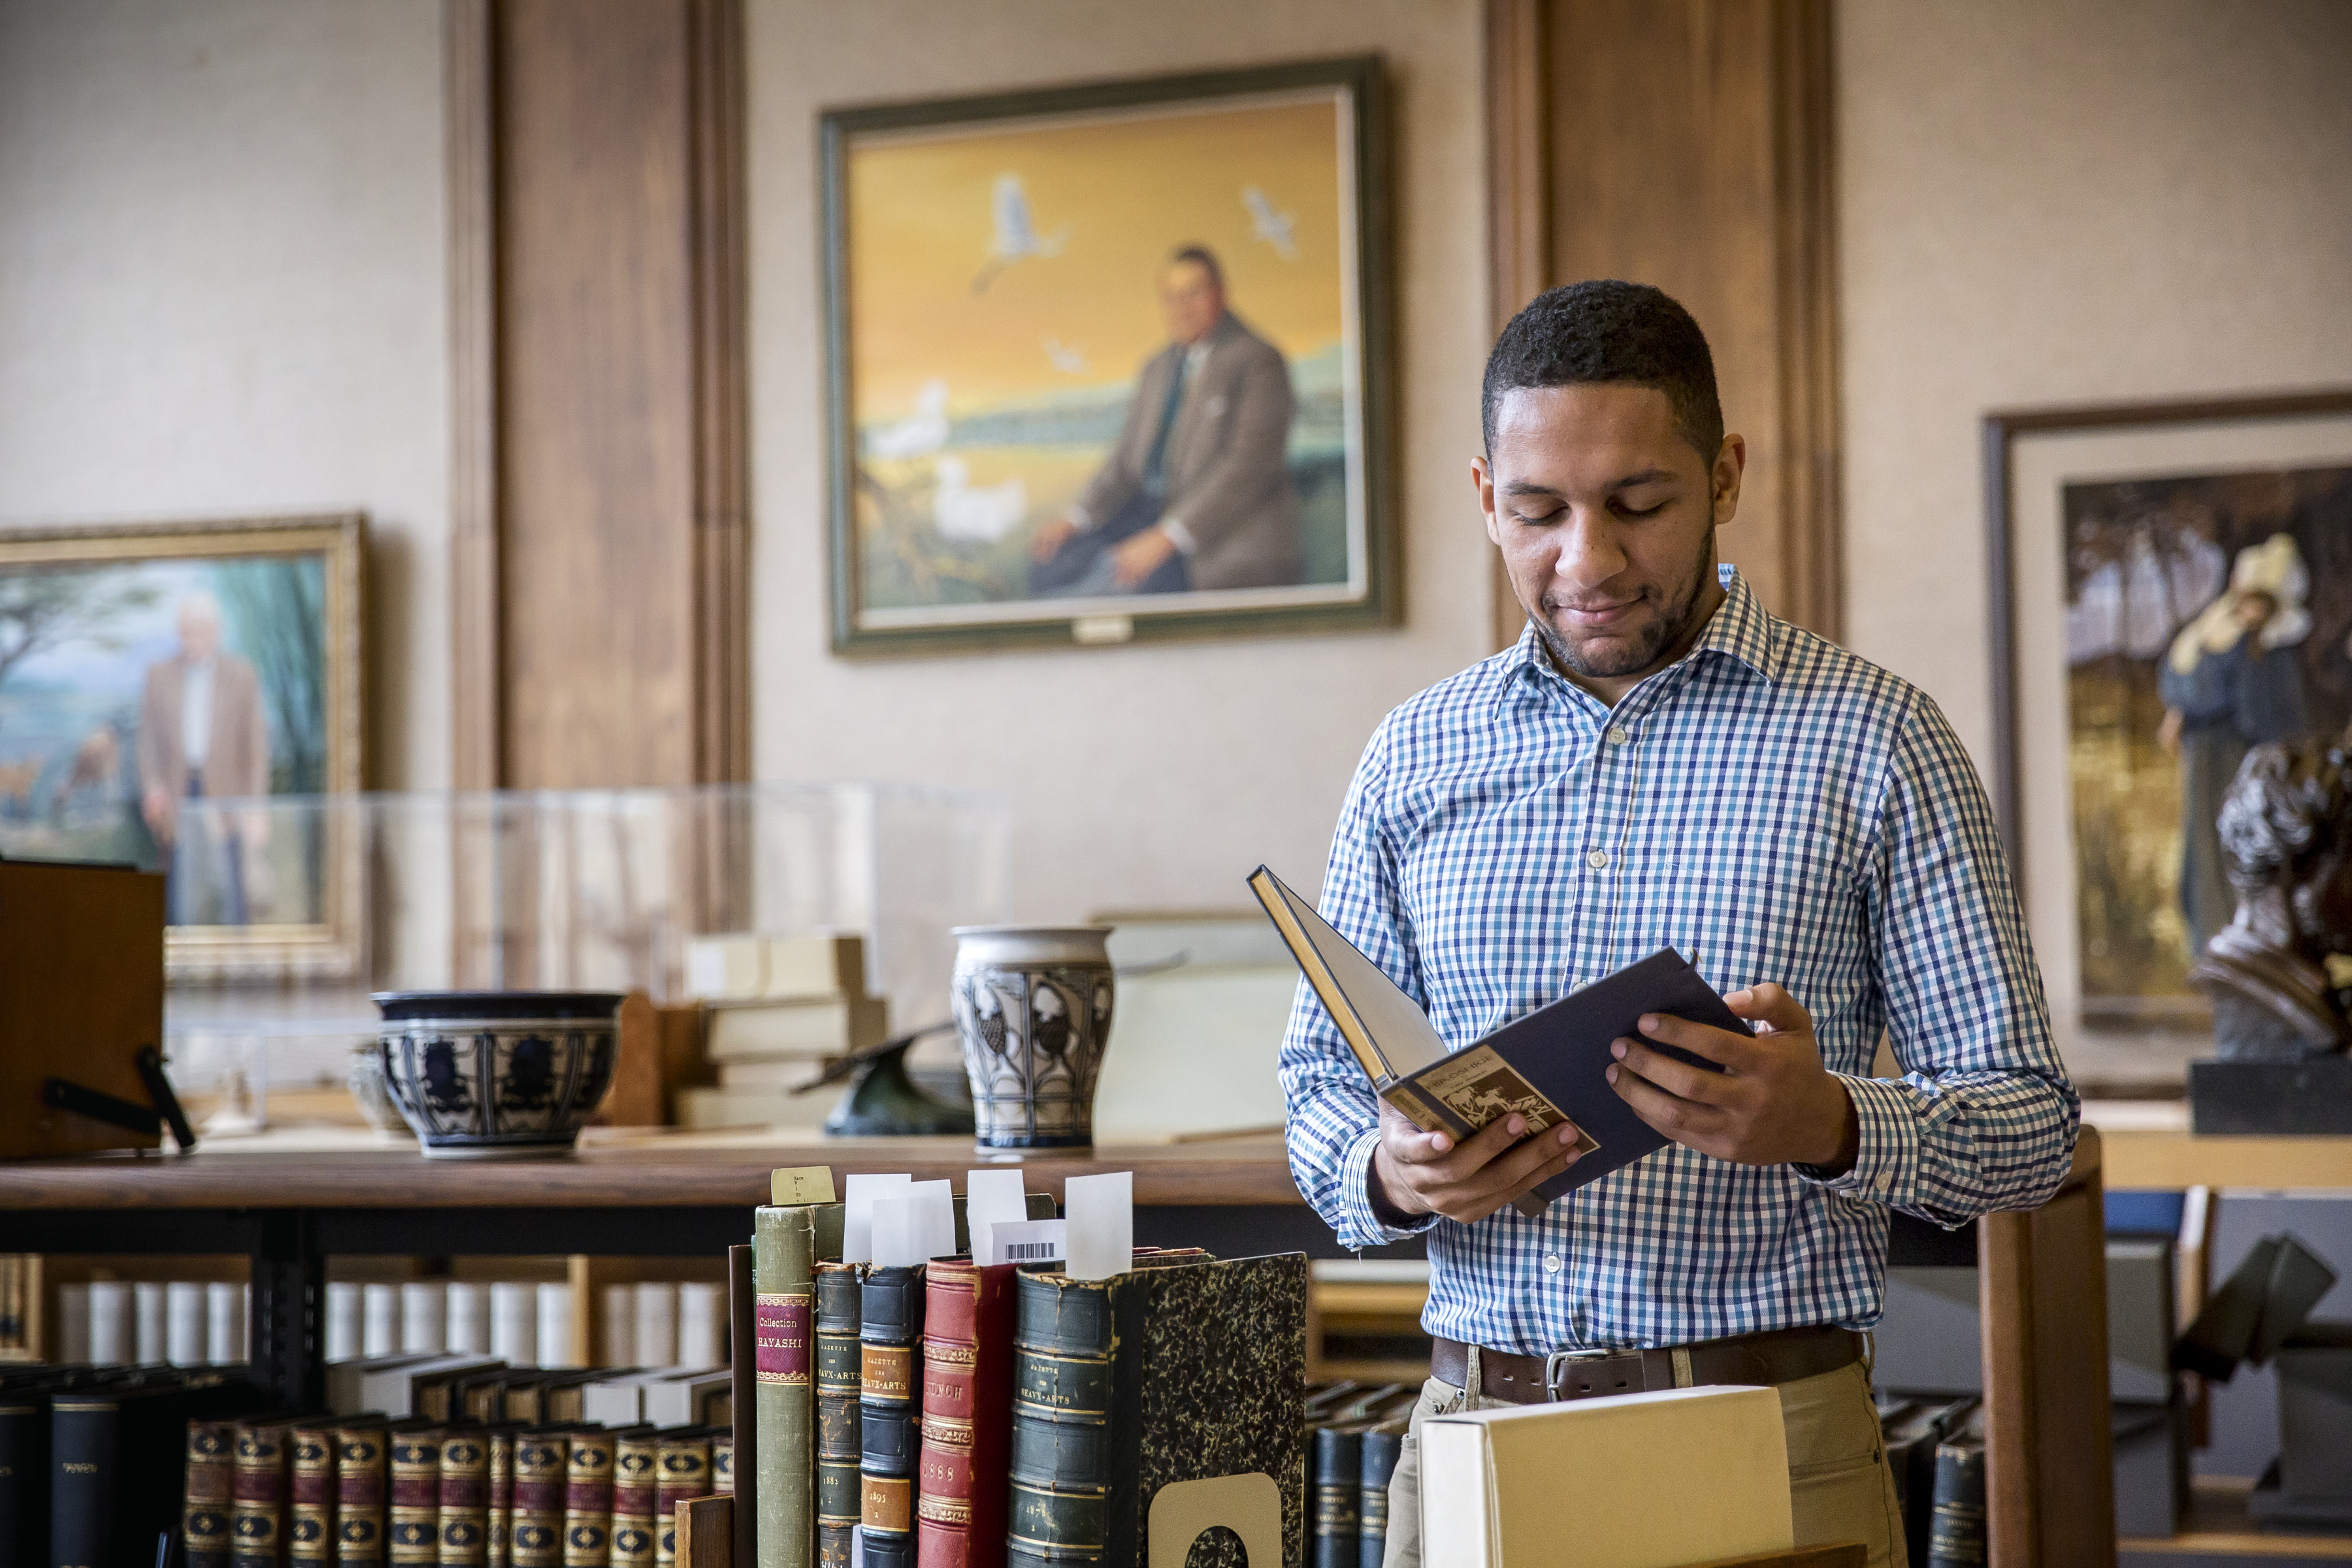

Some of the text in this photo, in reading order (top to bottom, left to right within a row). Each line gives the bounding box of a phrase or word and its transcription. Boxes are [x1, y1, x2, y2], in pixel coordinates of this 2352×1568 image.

[1426, 1054, 1494, 1090] HIROSHIGE
[759, 1317, 797, 1328] Collection
[758, 1337, 802, 1348] HAYASHI
[867, 1356, 896, 1366] GAZETTE
[926, 1381, 962, 1400] PUNCH
[923, 1460, 953, 1481] 1888
[823, 1476, 839, 1485] 1882
[870, 1491, 886, 1503] 1895
